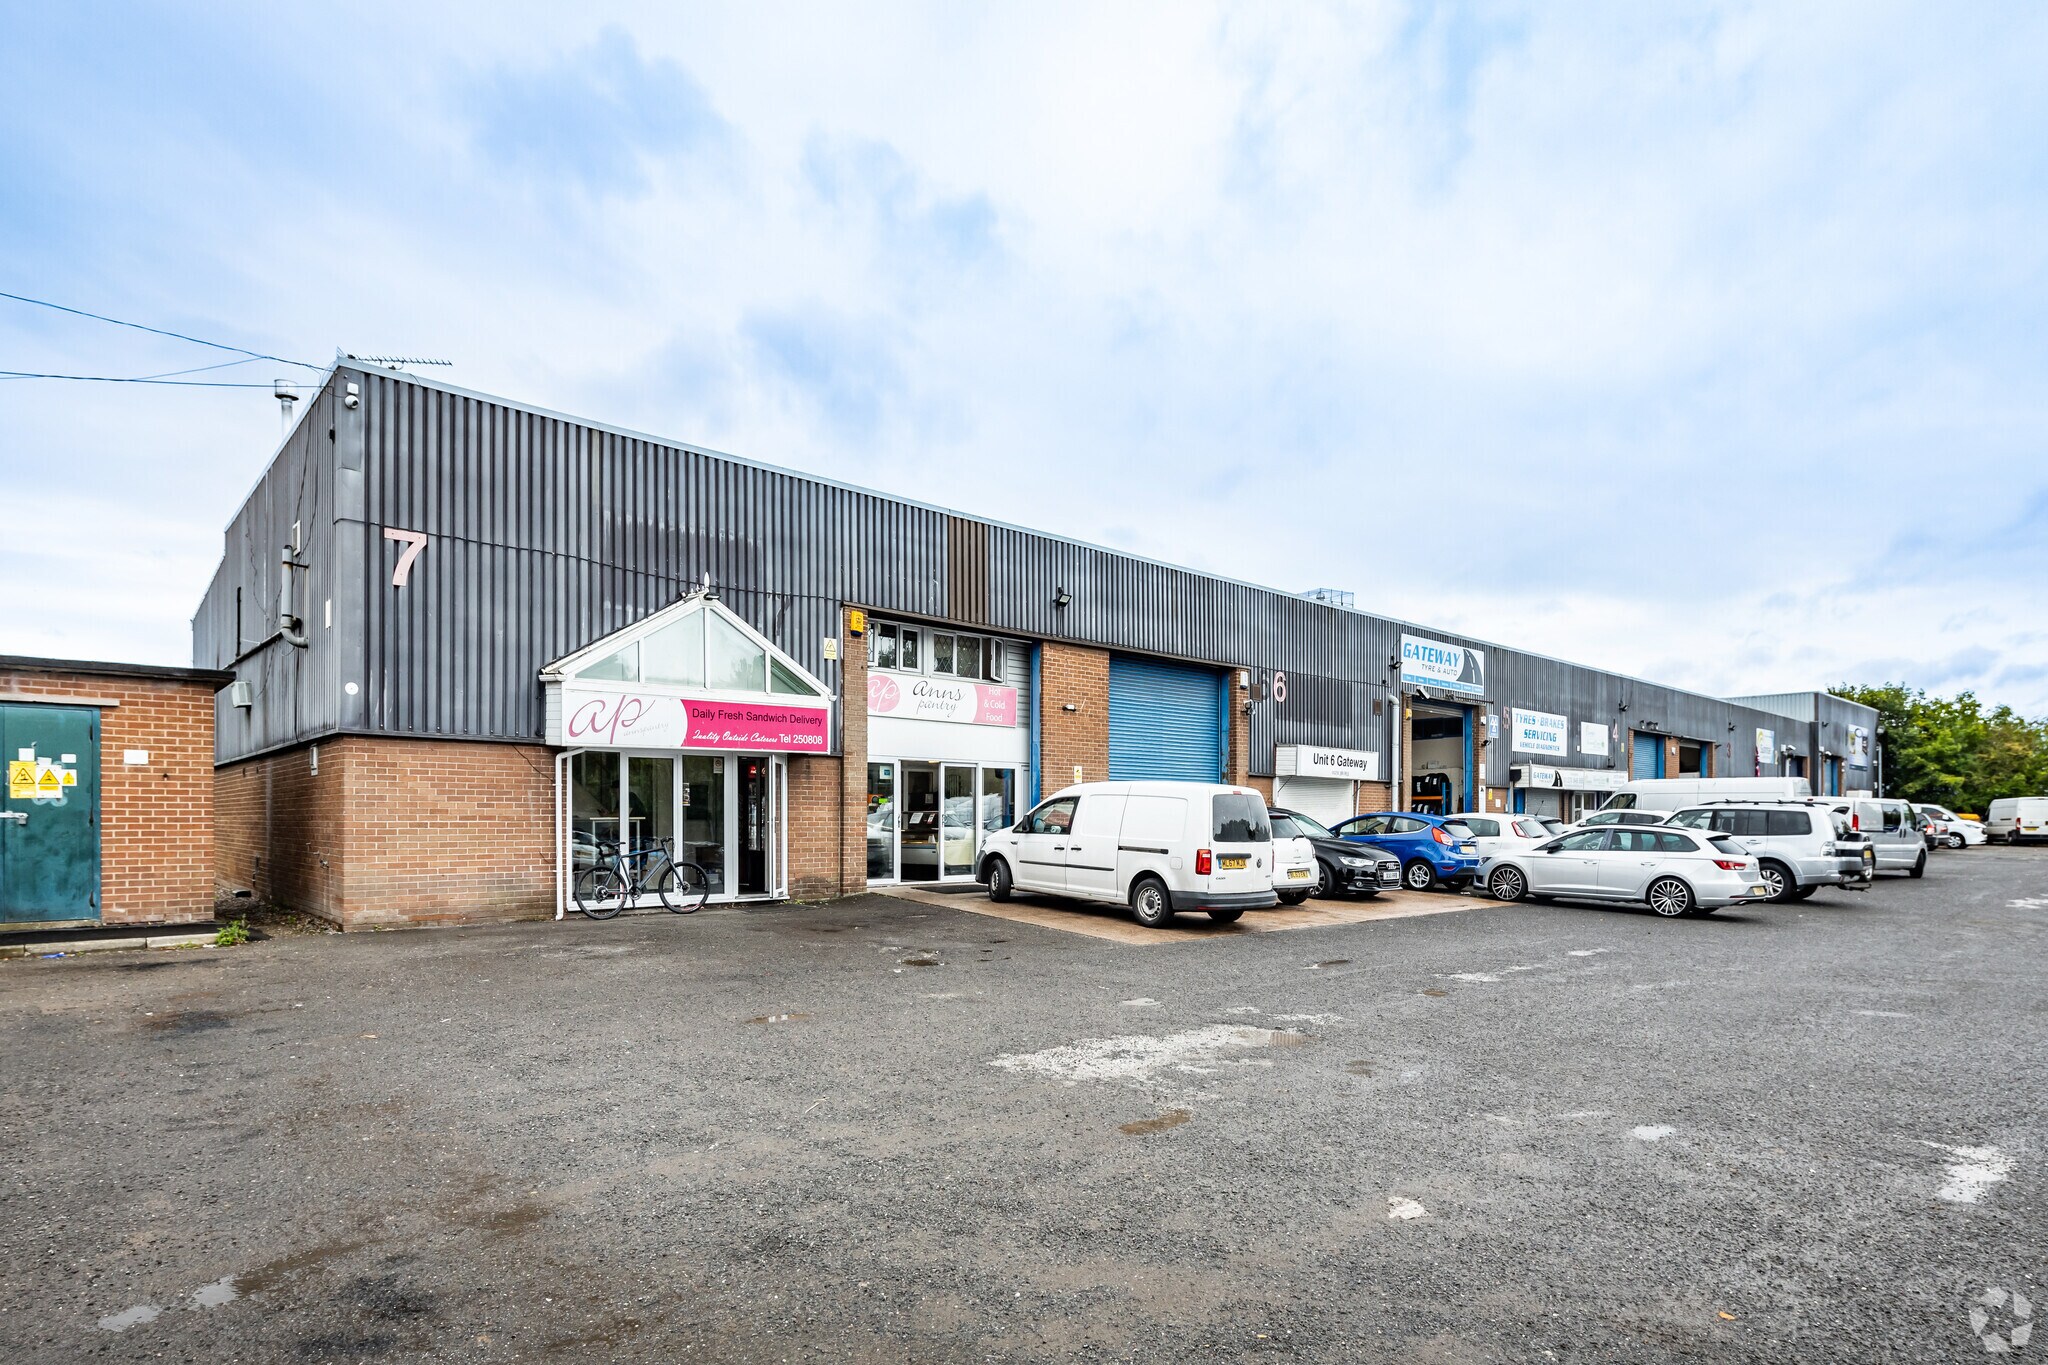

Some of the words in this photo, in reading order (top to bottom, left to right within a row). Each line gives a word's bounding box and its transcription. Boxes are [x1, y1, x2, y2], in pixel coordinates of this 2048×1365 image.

[384, 527, 427, 587] 7
[1403, 642, 1460, 667] GATEWAY
[1421, 664, 1435, 672] TYRE
[1443, 668, 1457, 676] AUTO
[912, 680, 966, 701] anns
[1273, 671, 1286, 702] 6
[916, 699, 958, 718] pantry
[990, 700, 1005, 710] Cold
[692, 708, 715, 720] Daily
[718, 709, 743, 720] Fresh
[746, 711, 787, 723] Sandwich
[790, 714, 823, 726] Delivery
[985, 714, 1003, 722] Food
[1516, 713, 1536, 725] TYRES
[1540, 717, 1564, 729] BRAKES
[692, 730, 720, 743] Quality
[722, 731, 748, 741] Outside
[750, 733, 777, 743] Caterers
[779, 733, 791, 743] Tel
[793, 734, 823, 744] 250808
[1523, 729, 1557, 742] SERVICING
[1612, 723, 1619, 742] 4
[1520, 741, 1535, 749] VEHICLE
[1313, 753, 1329, 765] Unit
[1330, 754, 1335, 766] 6
[1337, 755, 1368, 771] Gateway
